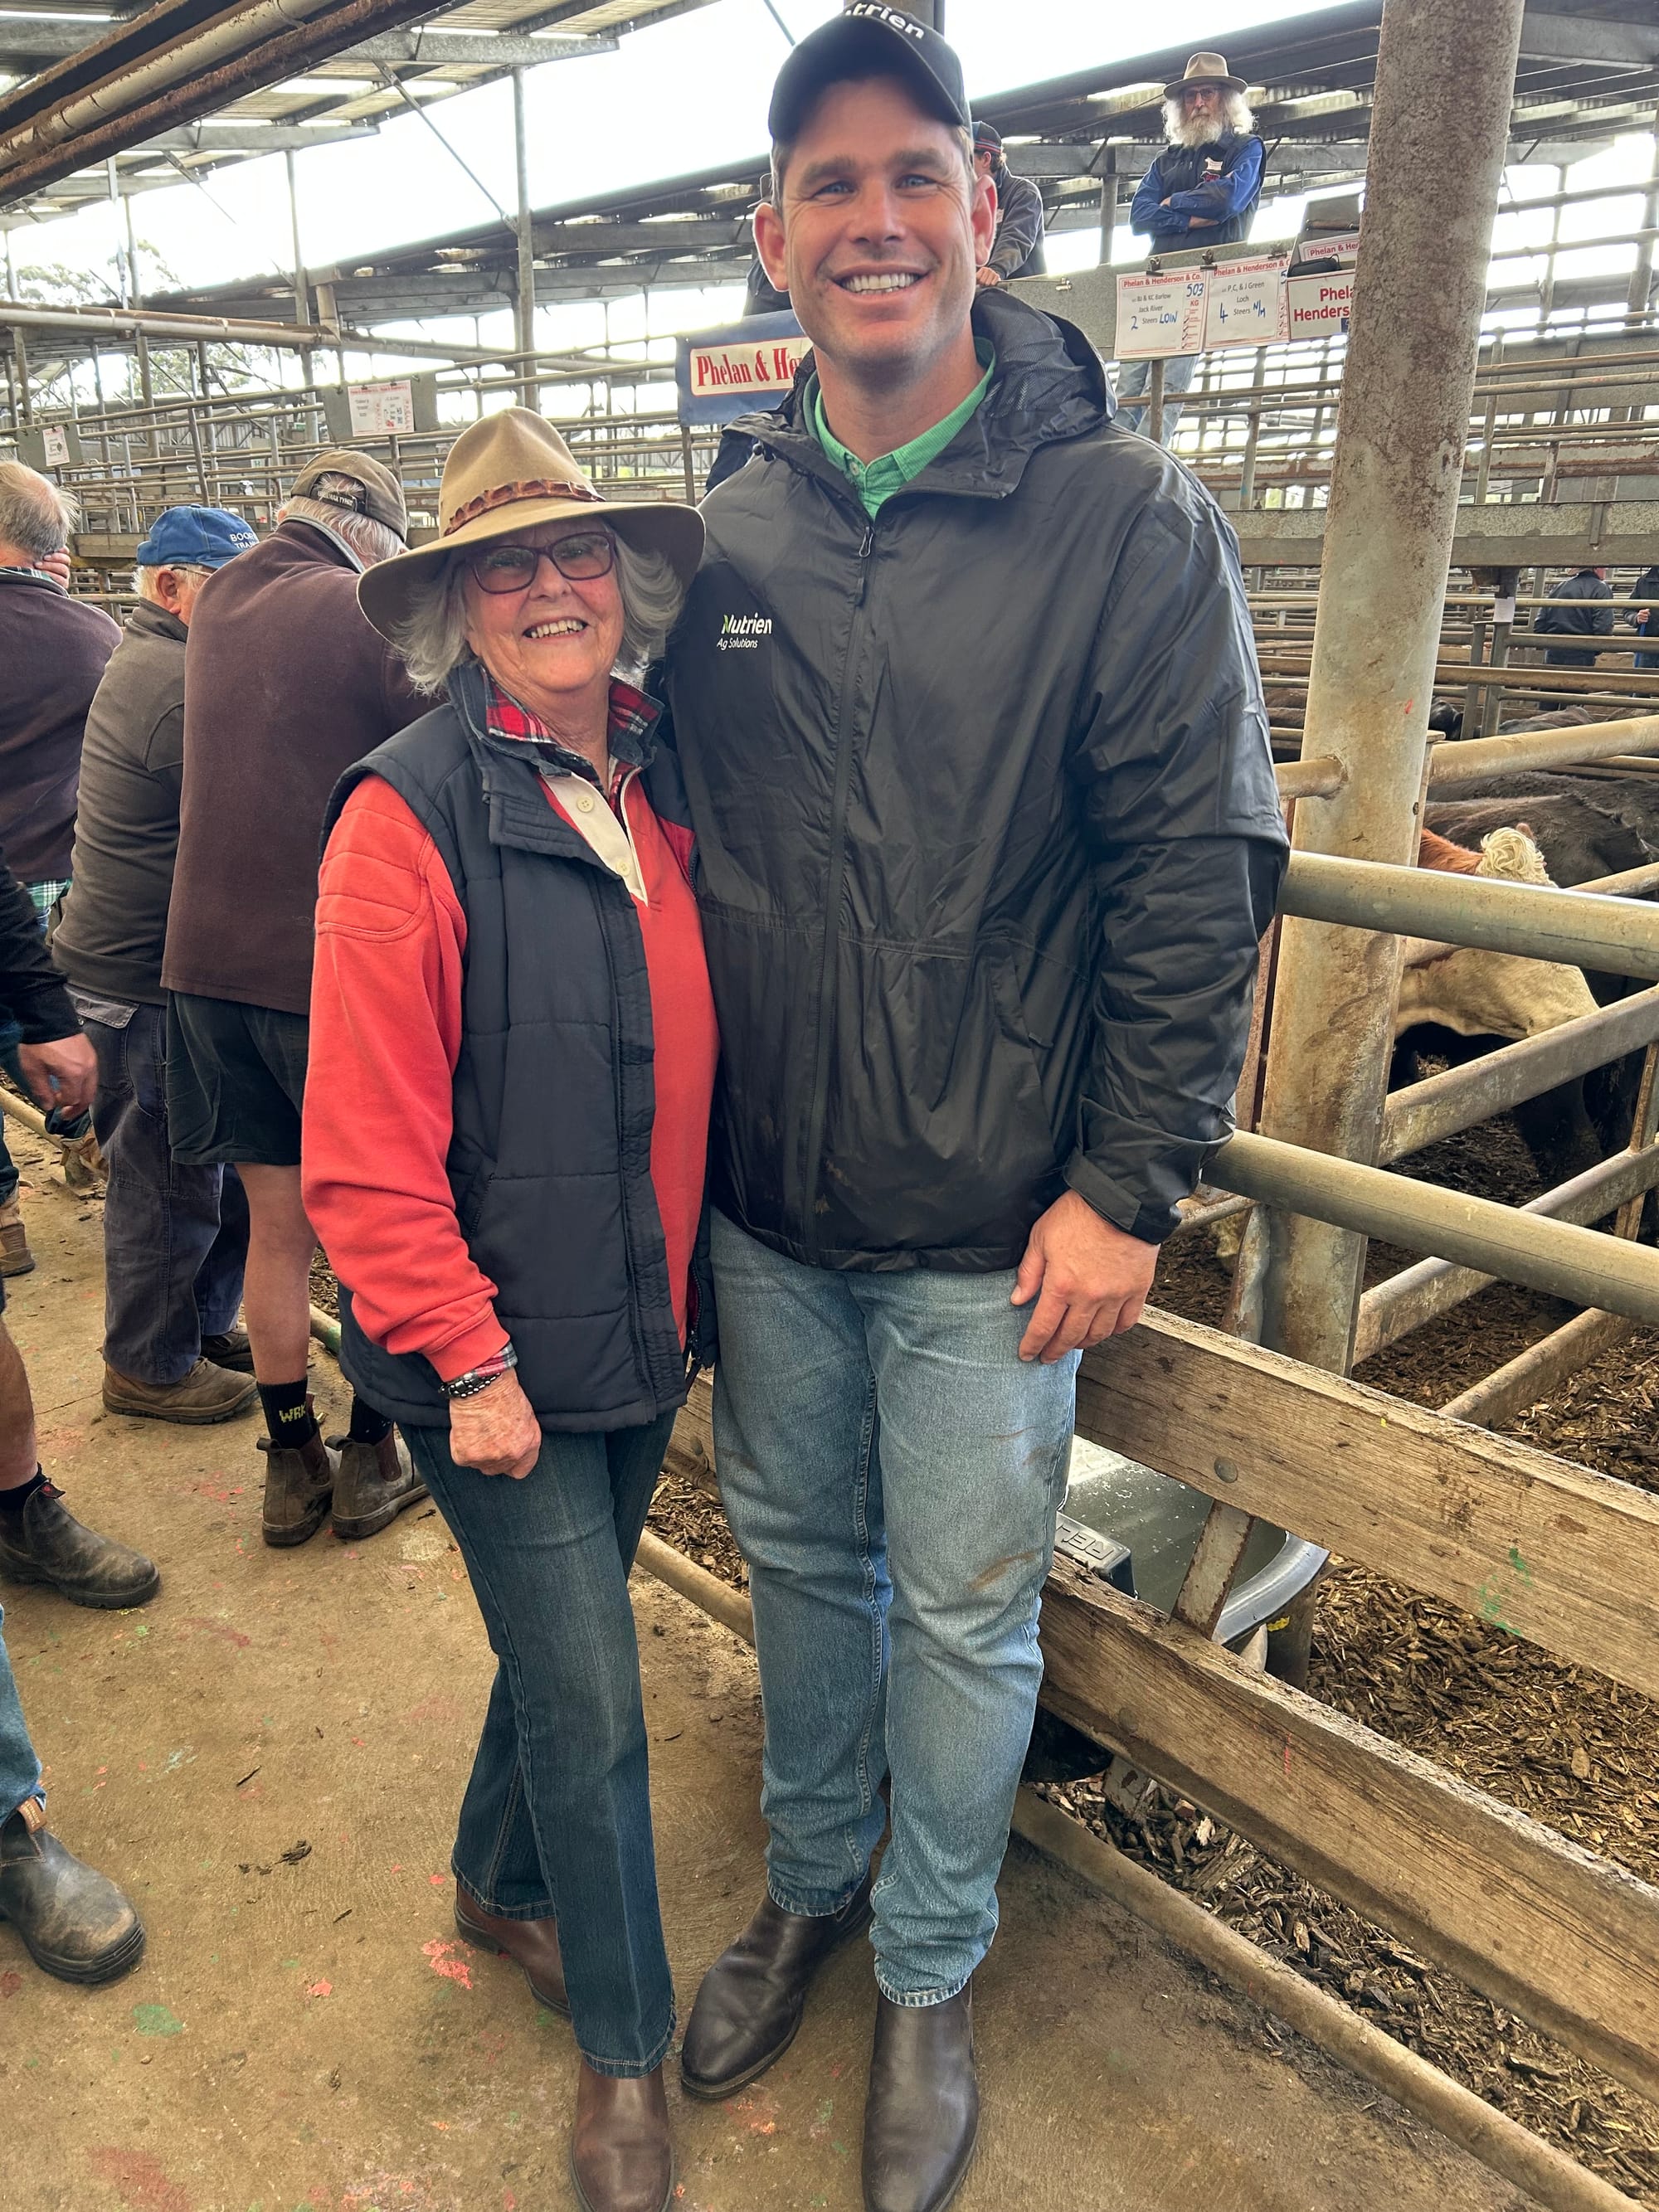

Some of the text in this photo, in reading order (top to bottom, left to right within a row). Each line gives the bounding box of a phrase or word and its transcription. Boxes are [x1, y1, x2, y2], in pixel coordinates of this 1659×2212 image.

[845, 2, 925, 39] trien
[1311, 246, 1336, 256] Phelan
[1214, 267, 1235, 276] Phelan
[1243, 261, 1277, 272] Henderson
[1124, 279, 1144, 288] Phelan
[1151, 275, 1185, 284] Henderson
[1248, 281, 1265, 289] Green
[1186, 283, 1204, 298] 503
[1219, 302, 1228, 323] 4
[1233, 308, 1251, 316] Steers
[1131, 315, 1139, 330] 2
[696, 348, 801, 387] Phelan & He
[721, 612, 772, 634] Nutrien
[717, 636, 758, 650] Ag Solutions
